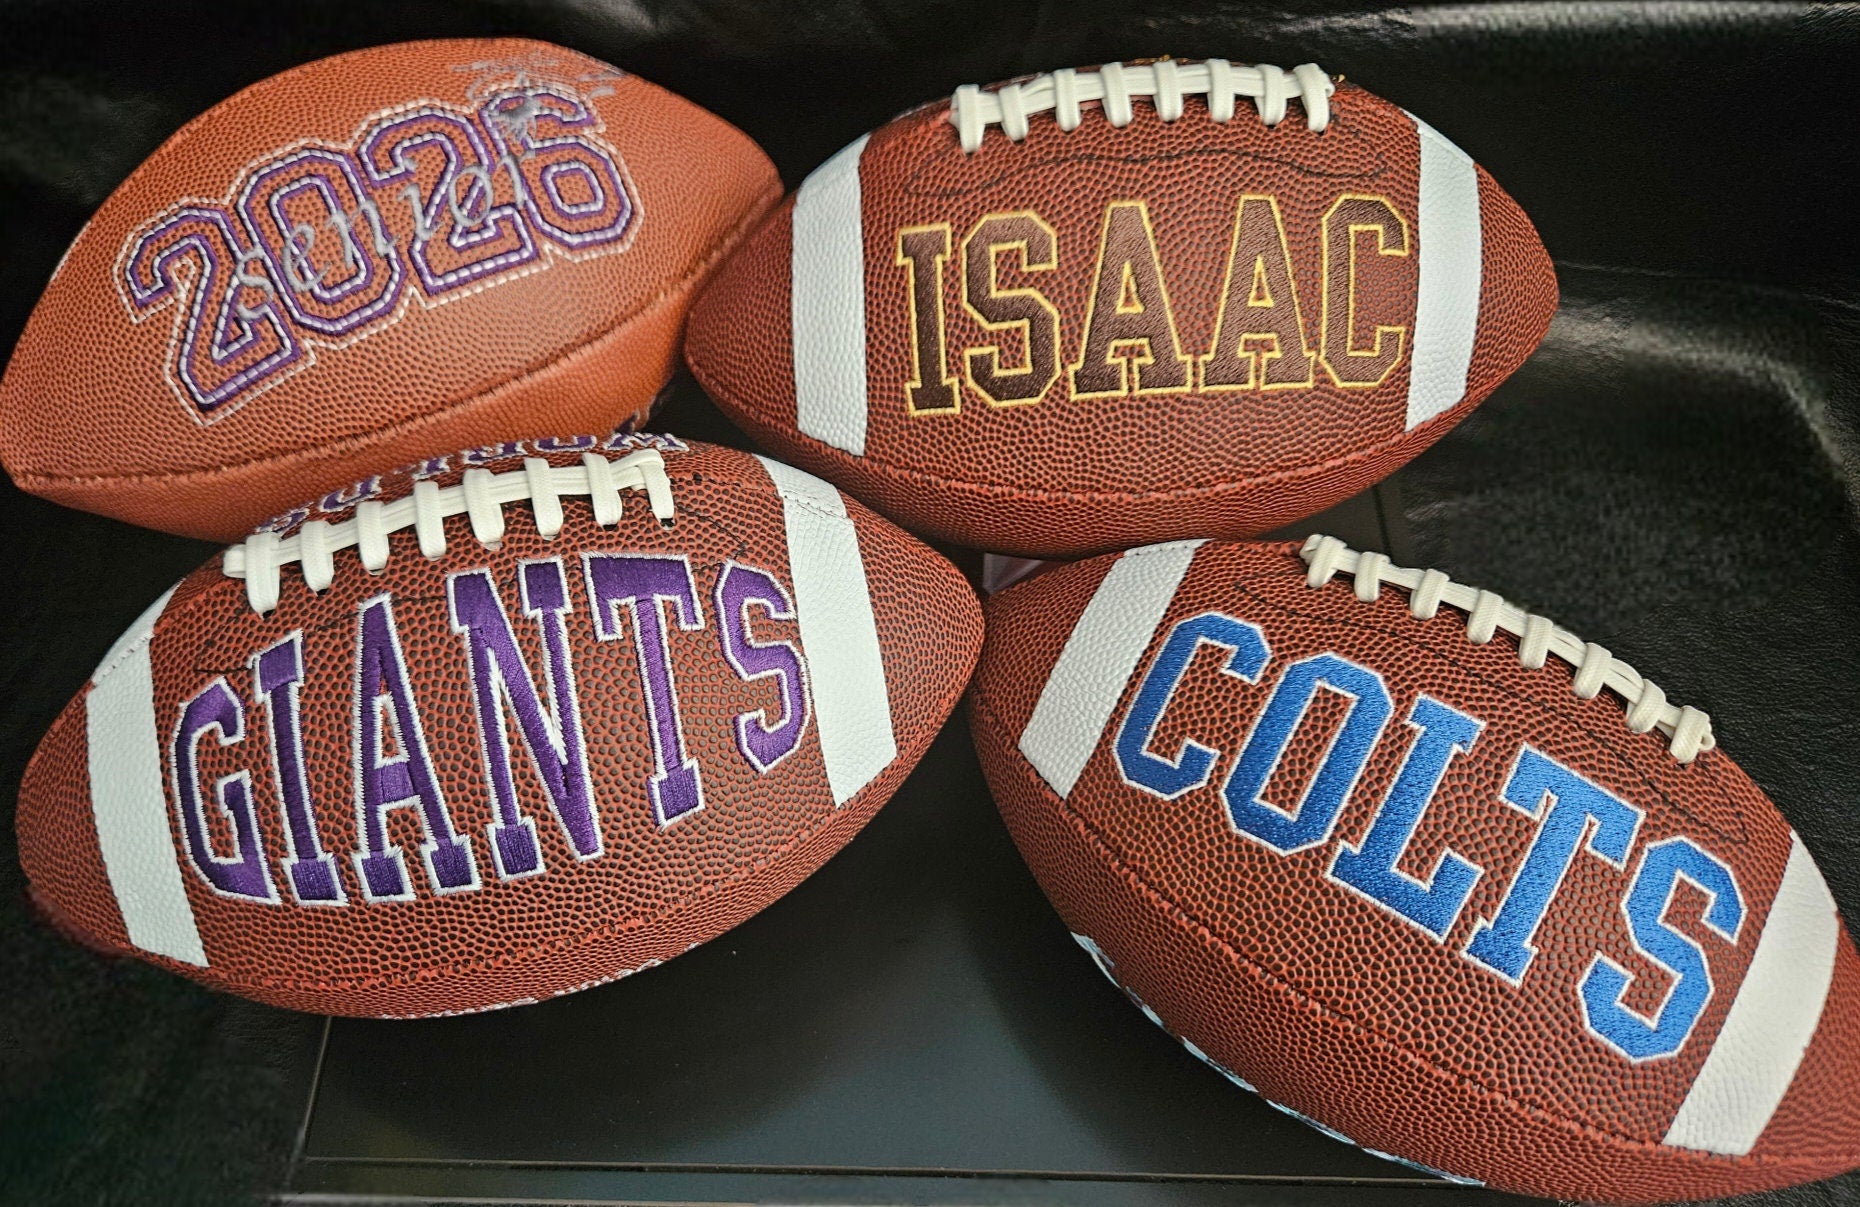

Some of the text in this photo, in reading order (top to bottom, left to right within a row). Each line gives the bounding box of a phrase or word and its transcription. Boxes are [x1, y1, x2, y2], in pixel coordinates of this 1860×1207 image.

[114, 80, 643, 424] 2026
[896, 193, 1408, 417] ISAAC
[170, 553, 811, 905] GIANTS
[1113, 611, 1748, 1063] COLTS
